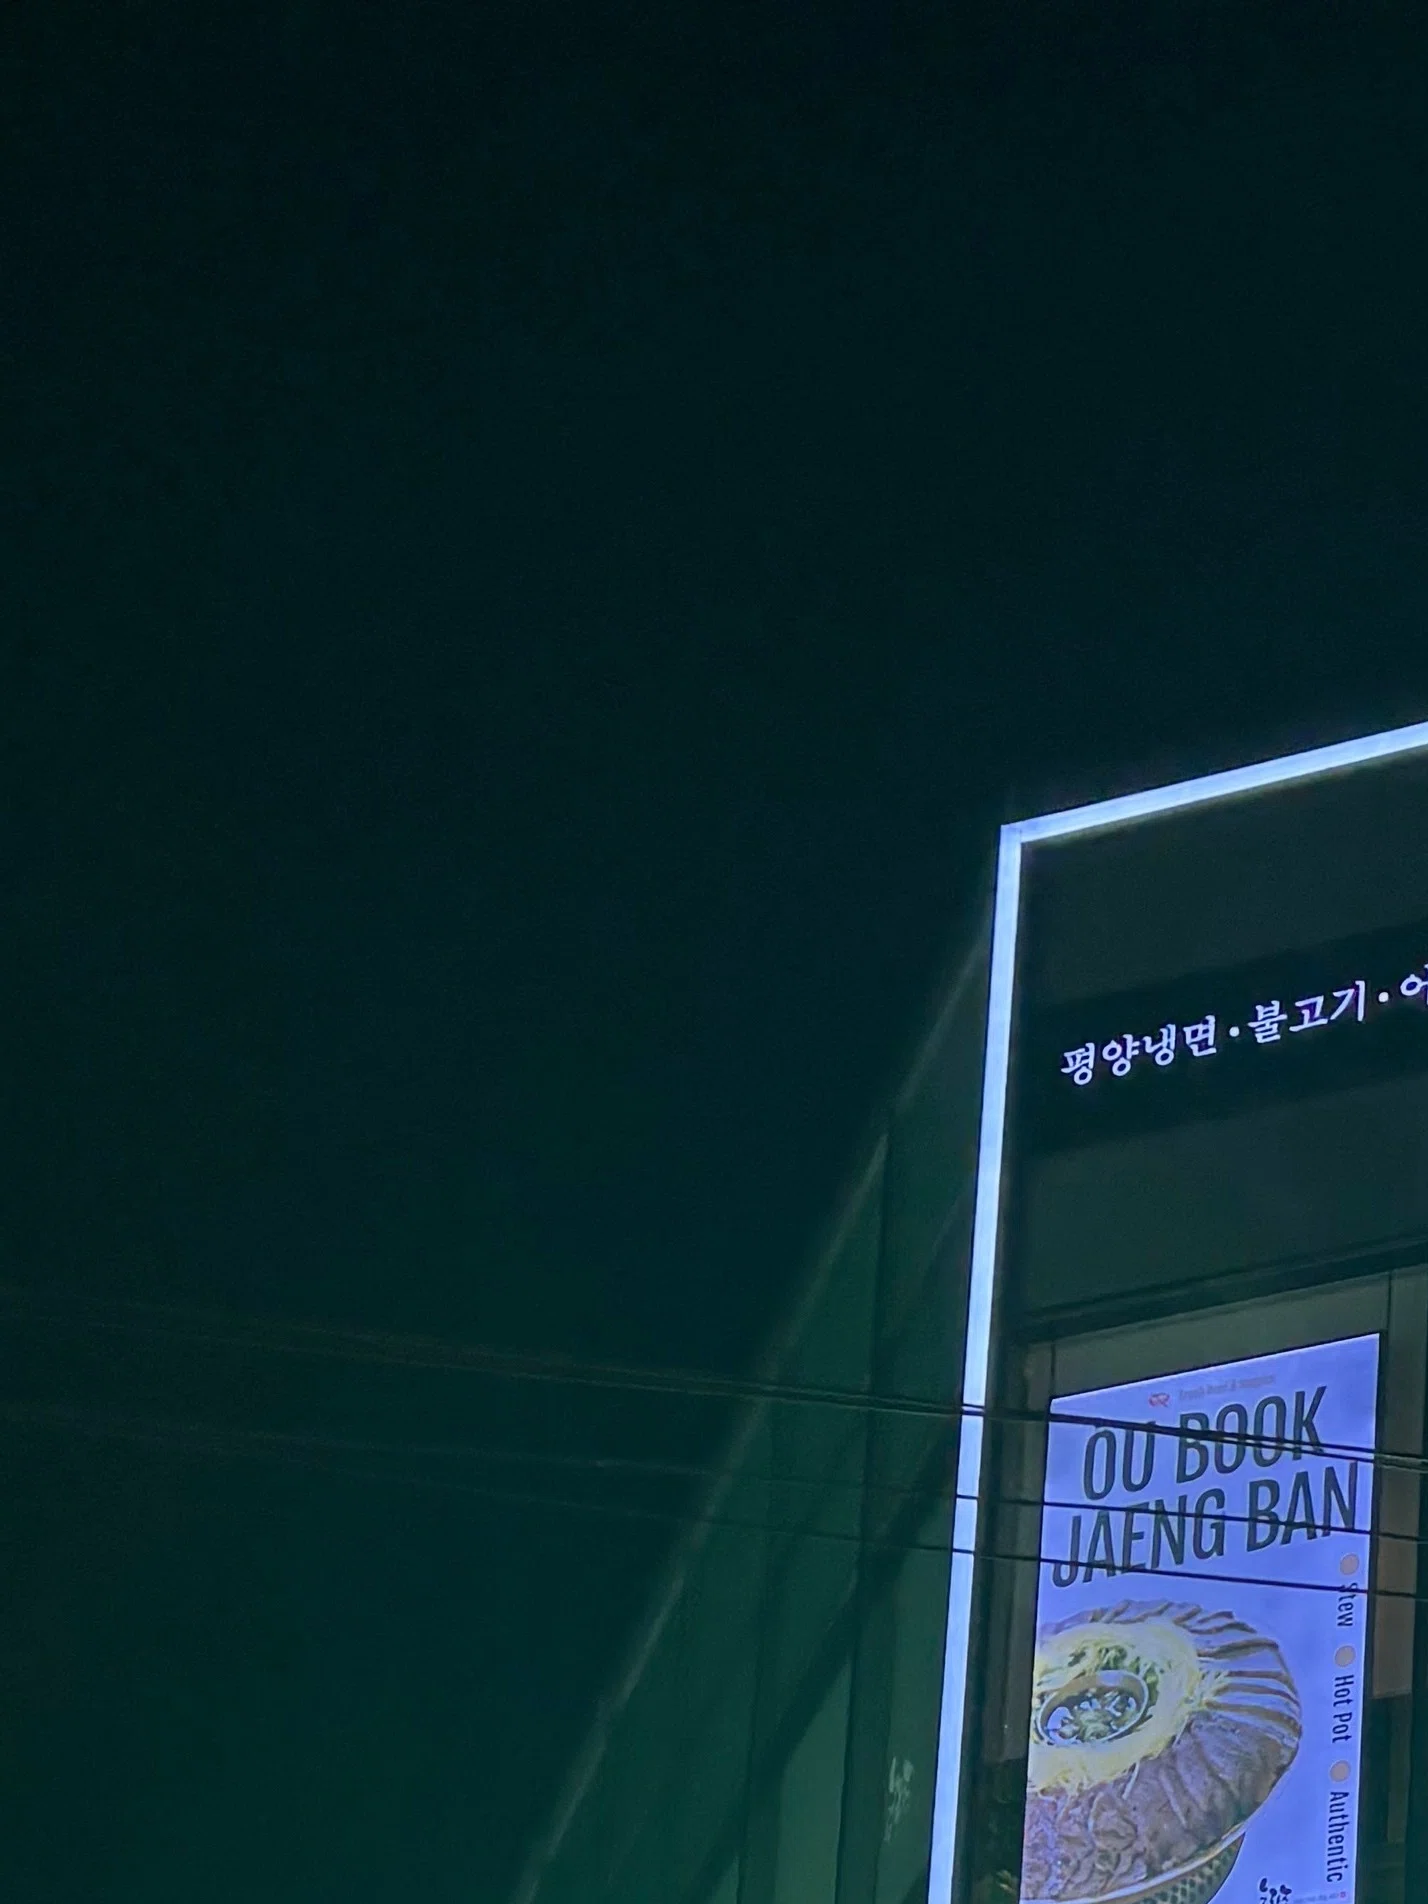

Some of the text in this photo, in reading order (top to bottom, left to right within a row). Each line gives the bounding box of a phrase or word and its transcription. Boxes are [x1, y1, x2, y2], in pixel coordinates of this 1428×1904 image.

[1083, 1385, 1328, 1501] OU BOOK
[1051, 1460, 1359, 1589] JAENG BAN
[1337, 1582, 1359, 1628] Stew
[1331, 1674, 1355, 1745] Hot Pot
[1326, 1790, 1350, 1883] Authentic
